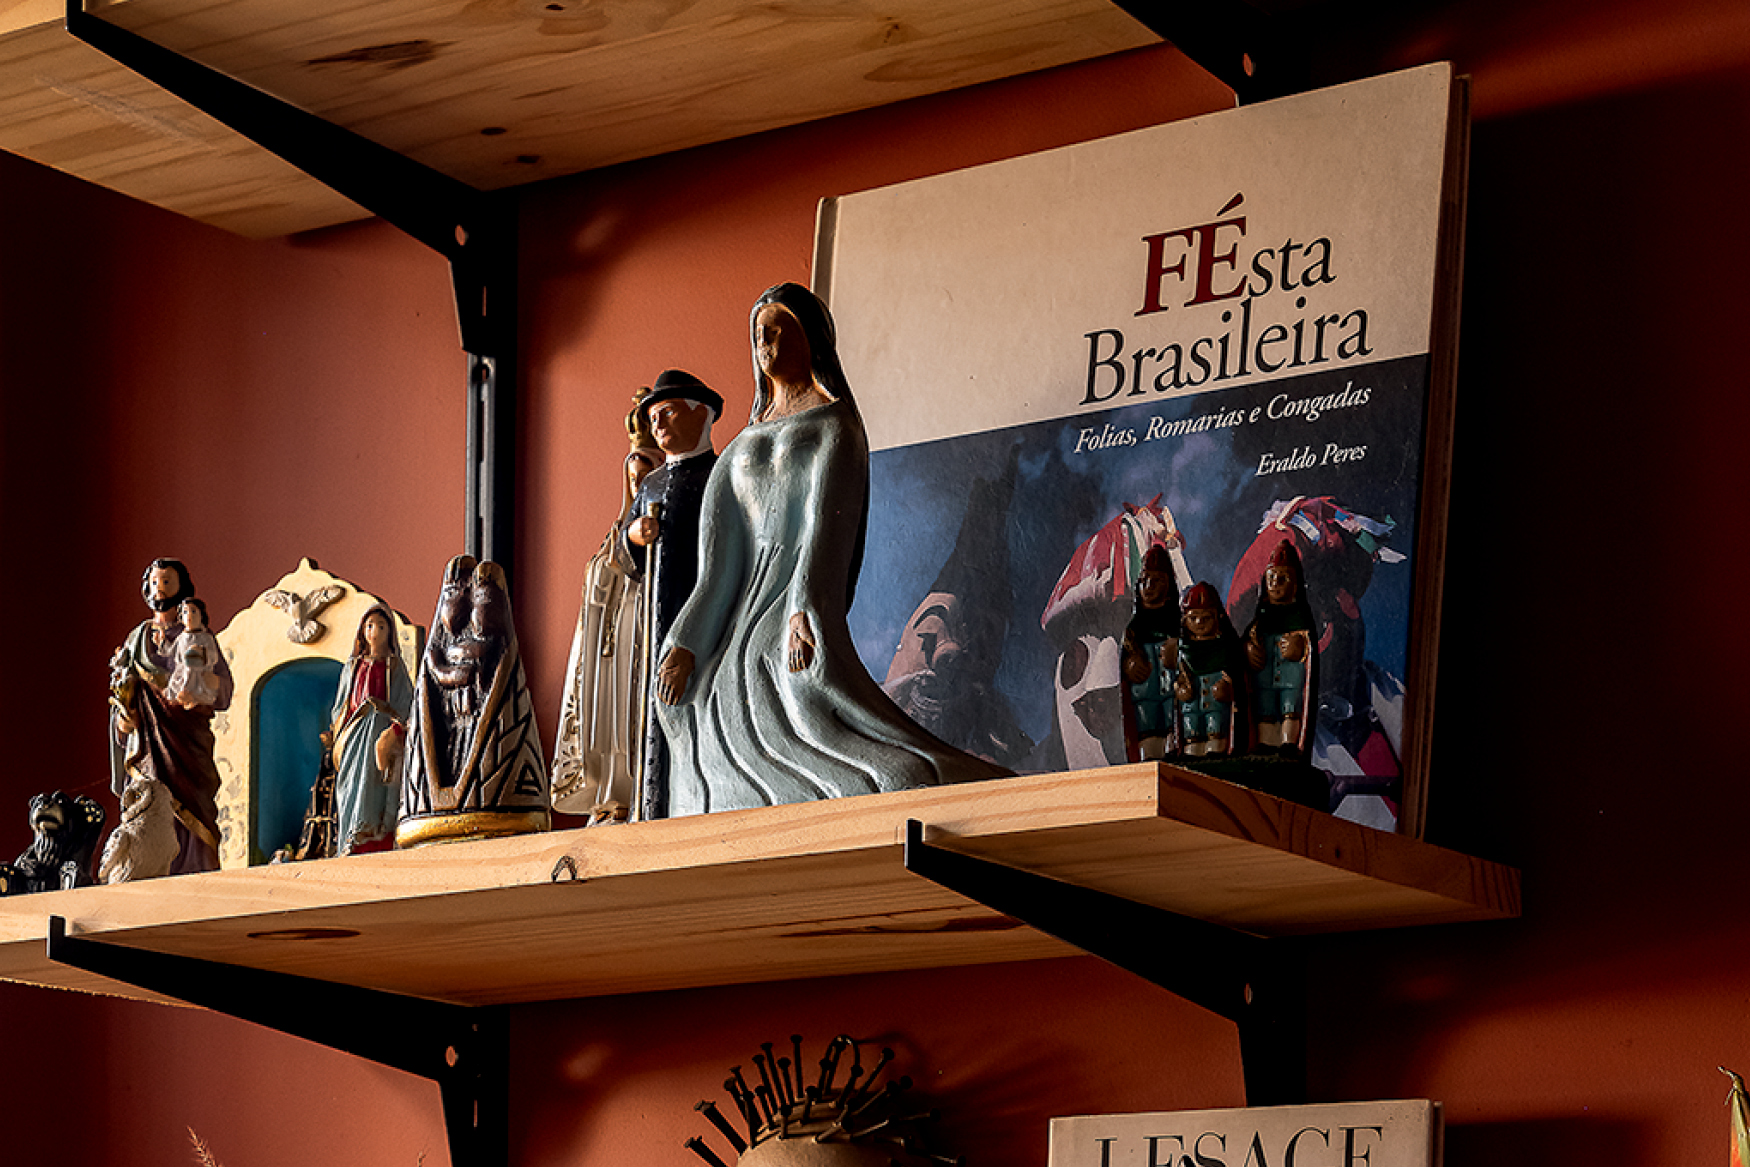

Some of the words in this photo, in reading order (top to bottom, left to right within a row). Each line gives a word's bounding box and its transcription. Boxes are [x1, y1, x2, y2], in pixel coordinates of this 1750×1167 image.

[1134, 192, 1337, 317] FÉsta
[1079, 296, 1373, 406] Brasileira
[1074, 427, 1138, 454] Folias,
[1144, 408, 1244, 441] Romarias
[1249, 407, 1258, 423] e
[1267, 381, 1372, 422] Congadas
[1255, 446, 1316, 477] Eraldo
[1320, 443, 1367, 466] Peres
